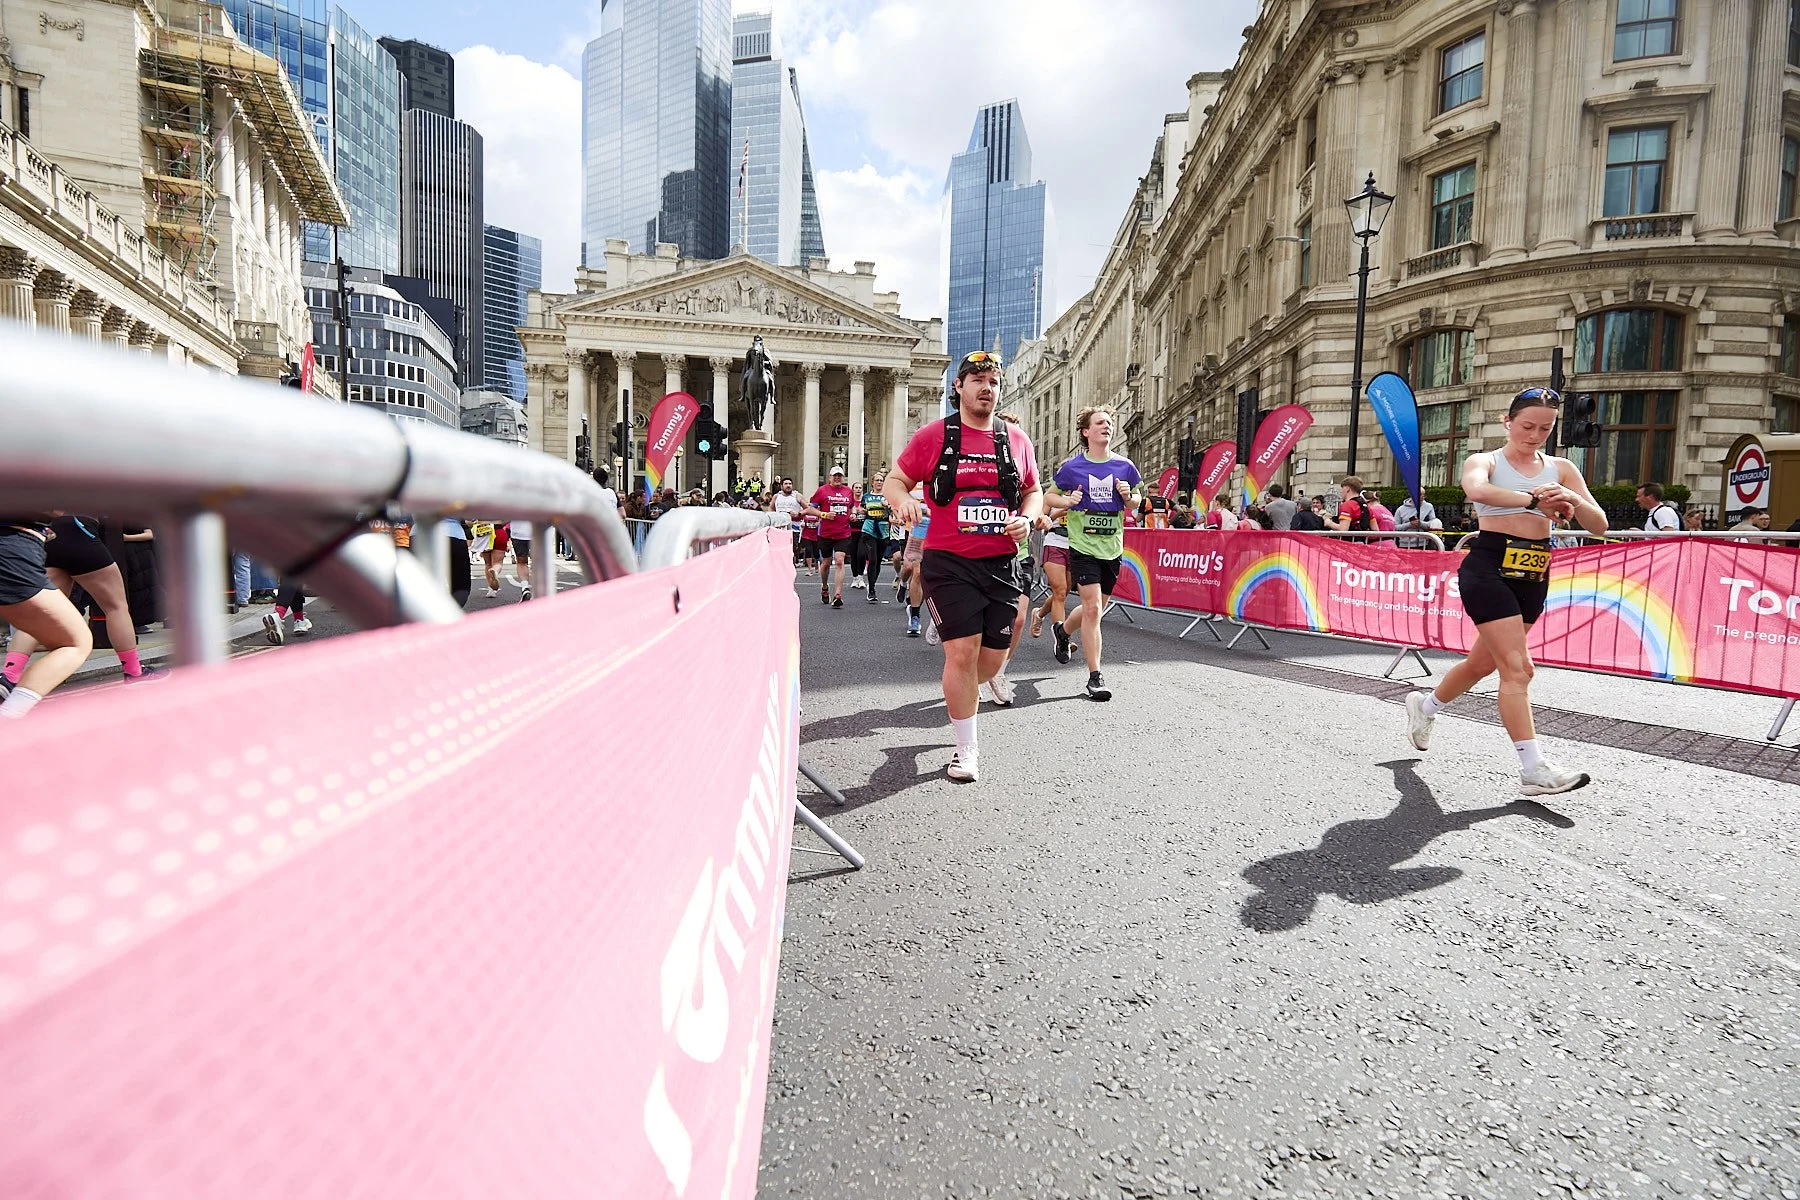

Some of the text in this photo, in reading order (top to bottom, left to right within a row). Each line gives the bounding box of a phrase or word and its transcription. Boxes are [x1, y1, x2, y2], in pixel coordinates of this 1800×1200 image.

[653, 404, 685, 451] Tommy's
[1256, 416, 1297, 464] Tommy's
[1402, 443, 1411, 460] Smith
[1203, 450, 1232, 486] Tommy's
[1732, 470, 1768, 483] UNDERGROUND
[963, 508, 1006, 521] 11010
[1089, 517, 1113, 526] 6501
[1158, 548, 1224, 575] Tommy's
[1507, 551, 1549, 569] 1239
[1189, 577, 1201, 585] baby
[1202, 578, 1220, 587] charity
[1332, 561, 1461, 602] Tommy's
[1330, 593, 1463, 622] The pregnancy and baby charity
[1714, 625, 1800, 645] The pregna
